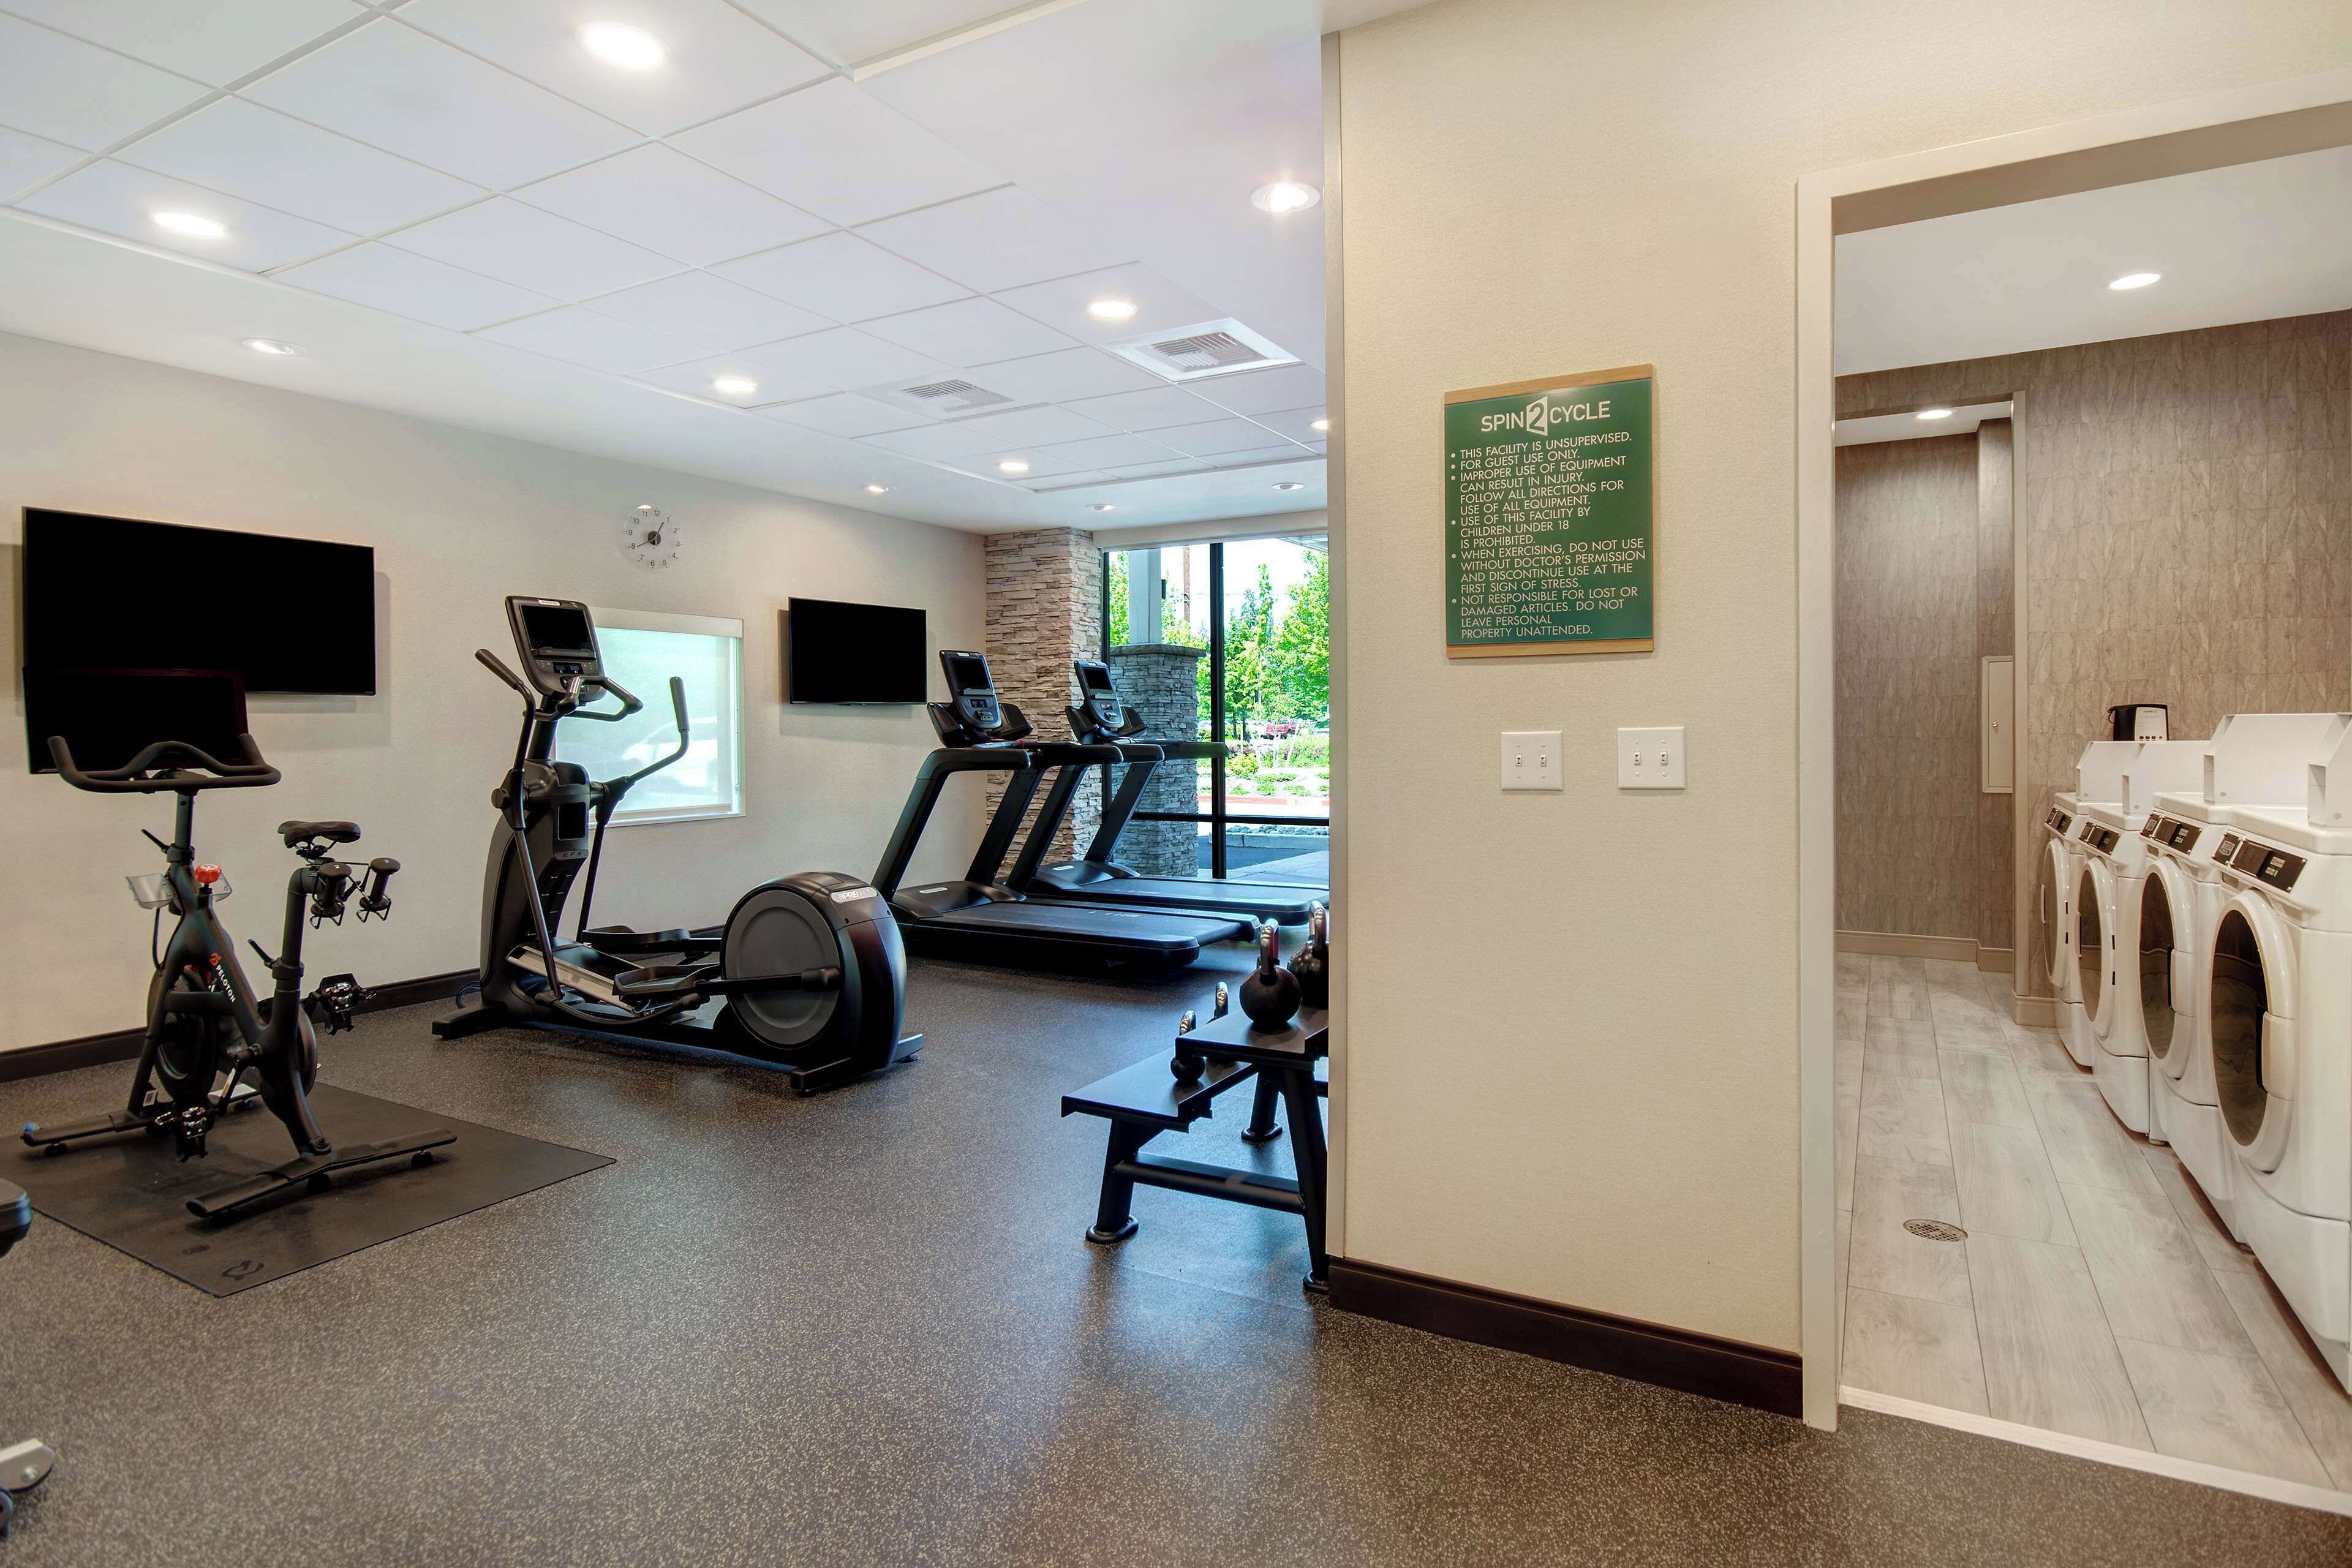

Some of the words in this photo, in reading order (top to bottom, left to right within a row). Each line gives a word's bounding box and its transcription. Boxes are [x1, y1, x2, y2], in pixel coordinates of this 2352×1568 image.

[1481, 411, 1524, 432] SPIN
[1529, 402, 1545, 432] 2
[1550, 400, 1611, 424] CYCLE
[1460, 448, 1482, 458] THIS
[1487, 442, 1528, 456] FACILITY
[1532, 441, 1541, 451] IS
[1546, 432, 1632, 449] UNSUPERVISED.
[1461, 459, 1481, 470] FOR
[1485, 455, 1519, 467] GUEST
[1524, 453, 1544, 463] USE
[1548, 449, 1580, 461] ONLY.
[1461, 468, 1512, 481] IMPROPER
[1516, 465, 1535, 475] USE
[1540, 463, 1555, 473] OF
[1561, 456, 1626, 471] EQUIPMENT
[1460, 482, 1484, 492] CAN
[1489, 478, 1524, 489] RESULT
[1529, 477, 1539, 486] IN
[1545, 472, 1584, 484] INJURY.
[1461, 491, 1504, 503] FOLLOW
[1508, 489, 1526, 499] ALL
[1530, 483, 1596, 497] DIRECTIONS
[1601, 480, 1624, 491] FOR
[1461, 505, 1479, 514] USE
[1483, 503, 1498, 513] OF
[1502, 501, 1520, 511] ALL
[1525, 495, 1590, 510] EQUIPMENT.
[1461, 516, 1480, 526] USE
[1484, 514, 1498, 524] OF
[1503, 512, 1525, 522] THIS
[1530, 508, 1573, 521] FACILITY
[1578, 507, 1590, 516] BY
[1461, 525, 1510, 537] CHILDREN
[1516, 522, 1553, 533] UNDER
[1558, 520, 1569, 529] 18
[1461, 539, 1469, 549] IS
[1474, 535, 1535, 548] PROHIBITED.
[1461, 549, 1494, 559] WHEN
[1499, 544, 1564, 557] EXERCISING,
[1570, 543, 1588, 552] DO
[1593, 540, 1617, 551] NOT
[1623, 538, 1643, 549] USE
[1461, 559, 1510, 570] WITHOUT
[1576, 550, 1645, 564] PERMISSION
[1461, 573, 1485, 582] AND
[1490, 567, 1563, 581] DISCONTINUE
[1569, 566, 1589, 576] USE
[1594, 565, 1607, 575] AT
[1612, 563, 1632, 573] THE
[1461, 584, 1486, 593] FIRST
[1490, 582, 1517, 592] SIGN
[1521, 581, 1536, 590] OF
[1541, 578, 1581, 589] STRESS.
[1461, 595, 1484, 605] NOT
[1489, 591, 1557, 603] RESPONSIBLE
[1562, 590, 1584, 599] FOR
[1589, 588, 1616, 598] LOST
[1621, 587, 1638, 597] OR
[1461, 605, 1517, 616] DAMAGED
[1521, 602, 1570, 612] ARTICLES.
[1577, 601, 1594, 611] DO
[1599, 599, 1624, 609] NOT
[1462, 617, 1491, 627] LEAVE
[1496, 615, 1551, 626] PERSONAL
[1462, 628, 1512, 638] PROPERTY
[1517, 625, 1593, 636] UNATTENDED.
[216, 965, 236, 1002] PELOTON
